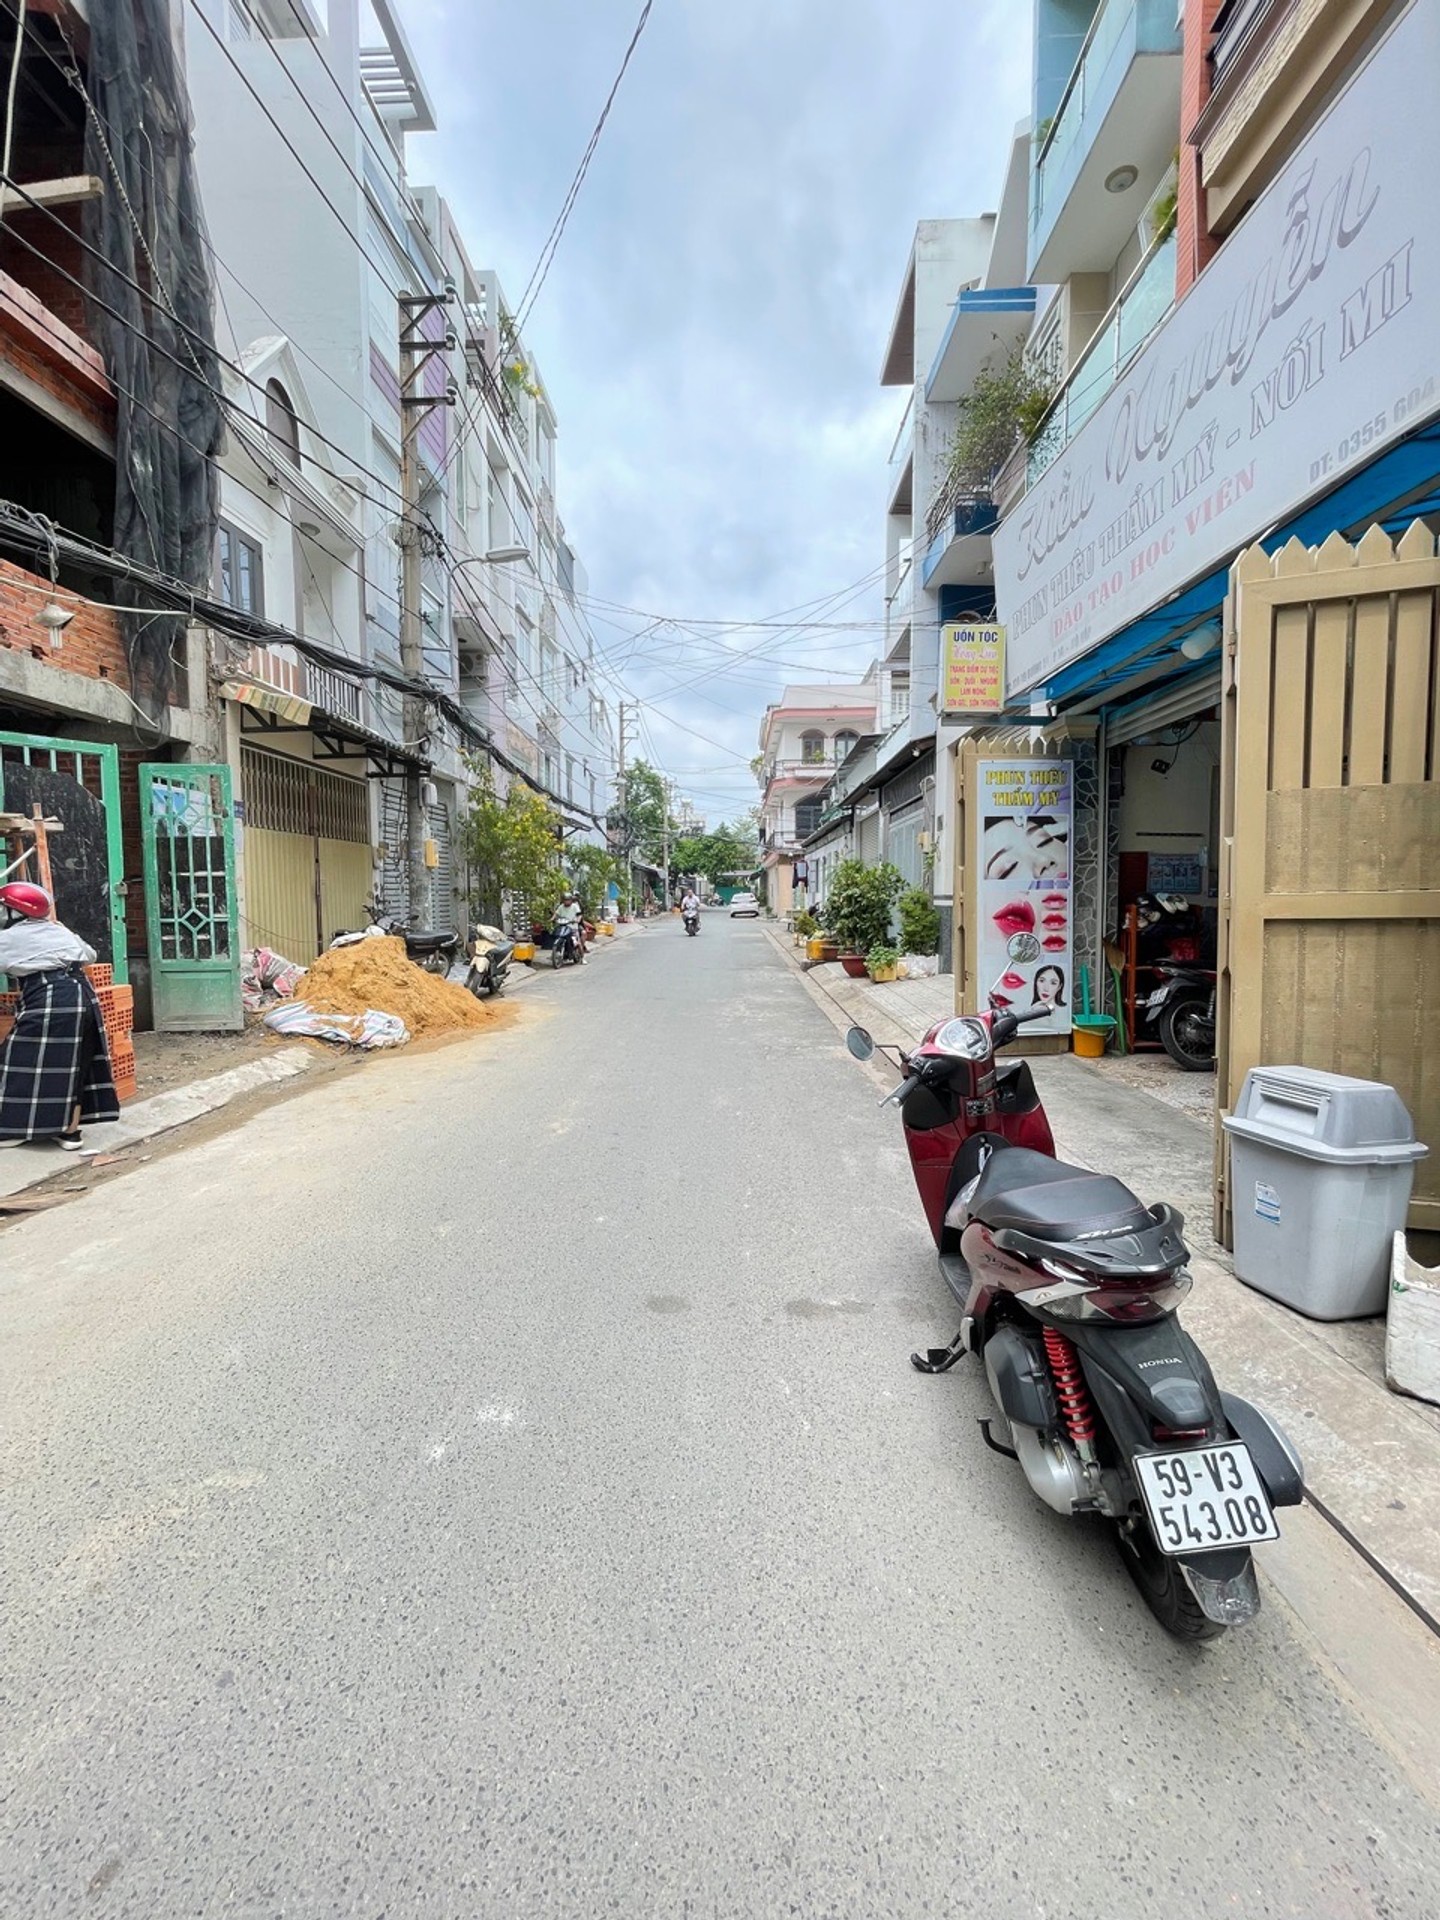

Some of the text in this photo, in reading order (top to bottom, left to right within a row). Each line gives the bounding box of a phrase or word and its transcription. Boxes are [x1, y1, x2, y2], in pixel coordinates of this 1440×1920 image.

[1250, 317, 1326, 440] NỐI
[1340, 237, 1414, 362] MI
[1130, 527, 1176, 582] HỌC
[1184, 458, 1257, 536] VIÊN
[978, 629, 999, 643] TÓC
[986, 770, 1026, 785] PHUN
[1137, 1357, 1183, 1369] HONDA
[1152, 1451, 1243, 1498] 59-V3
[1159, 1495, 1267, 1546] 543.08
